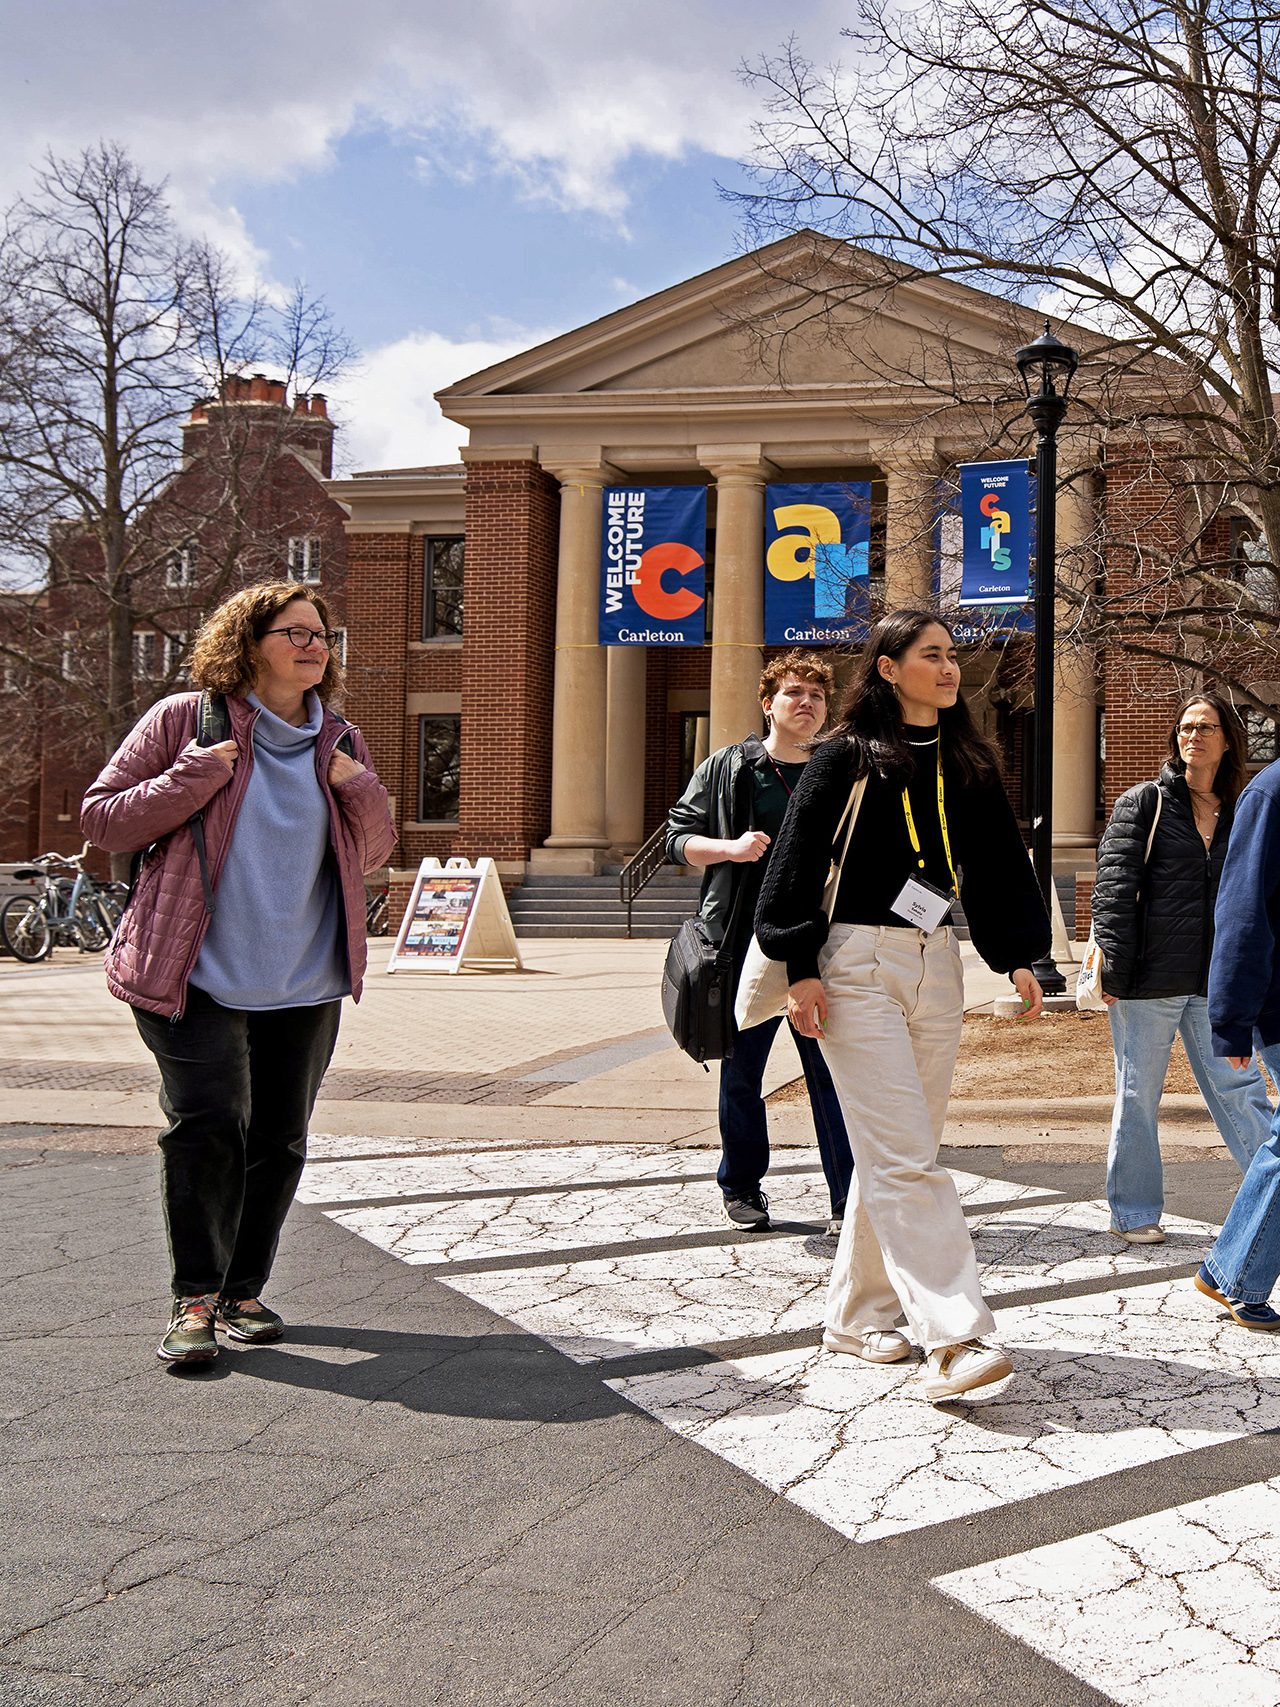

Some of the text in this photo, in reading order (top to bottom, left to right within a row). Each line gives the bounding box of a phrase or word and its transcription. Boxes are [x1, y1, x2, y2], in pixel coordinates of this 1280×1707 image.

[981, 475, 1009, 484] WELCOME
[983, 481, 1006, 489] FUTURE
[625, 492, 646, 586] FUTURE
[605, 492, 626, 614] WELCOME
[978, 585, 1011, 593] Carleton
[618, 628, 685, 642] Carleton
[784, 627, 850, 641] Carleton
